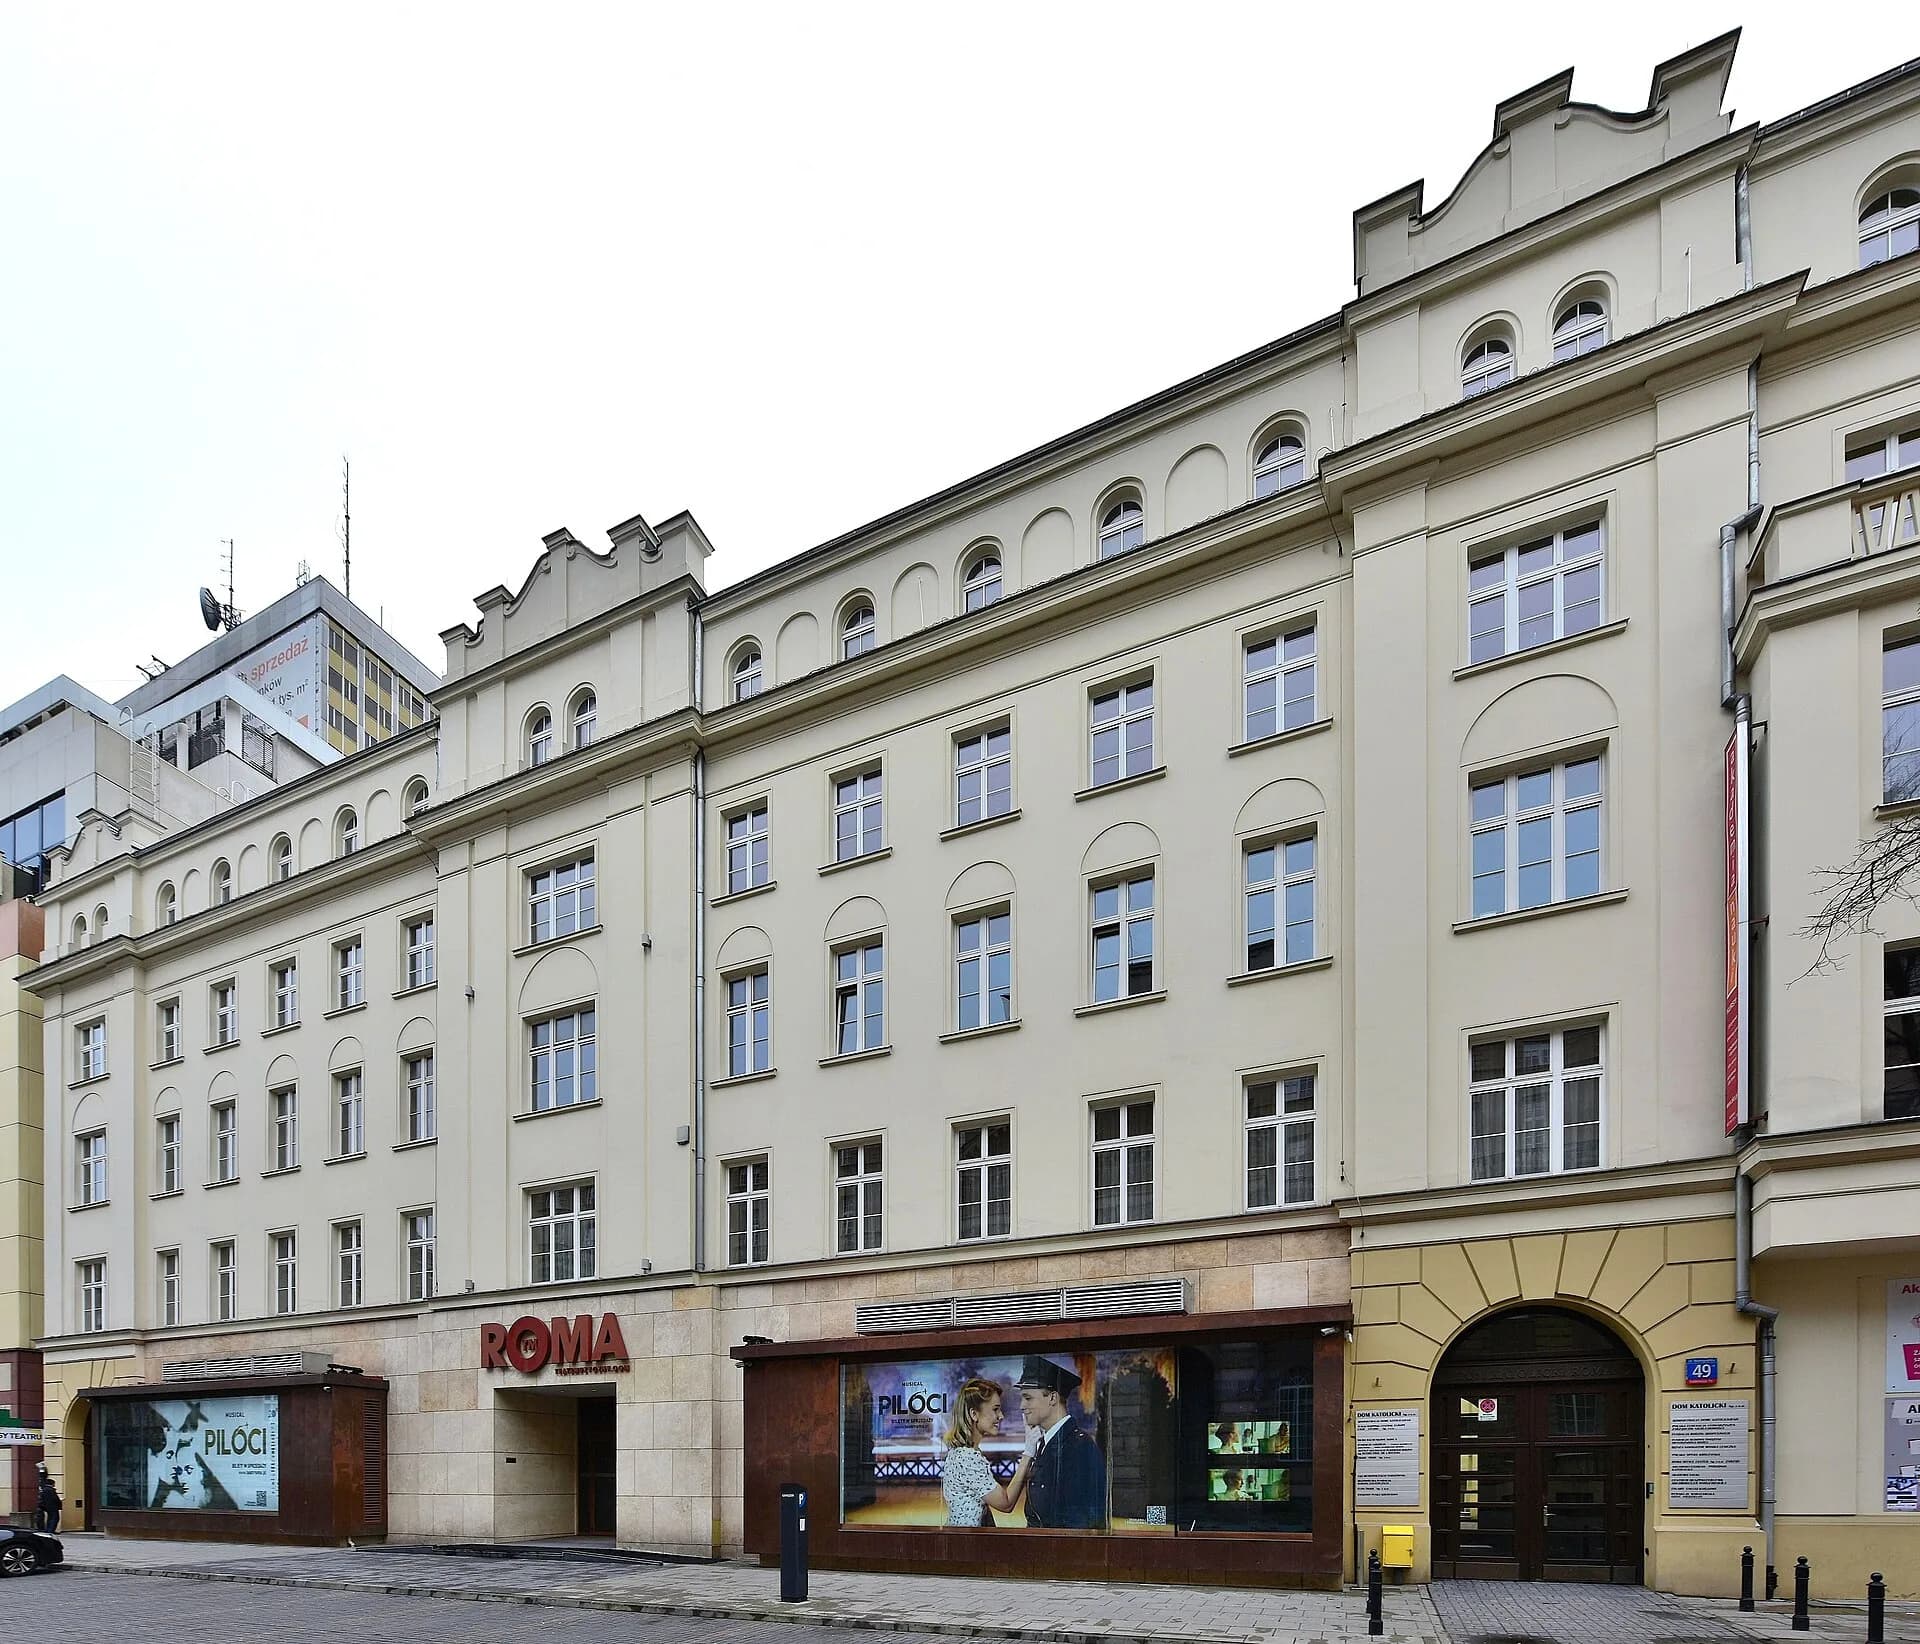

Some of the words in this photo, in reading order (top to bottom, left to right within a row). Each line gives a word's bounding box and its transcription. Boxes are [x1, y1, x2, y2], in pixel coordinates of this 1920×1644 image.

[251, 635, 309, 681] sprzedaż
[481, 1313, 630, 1373] ROMA
[1692, 1364, 1712, 1378] 49
[10, 1432, 42, 1441] TEATRU
